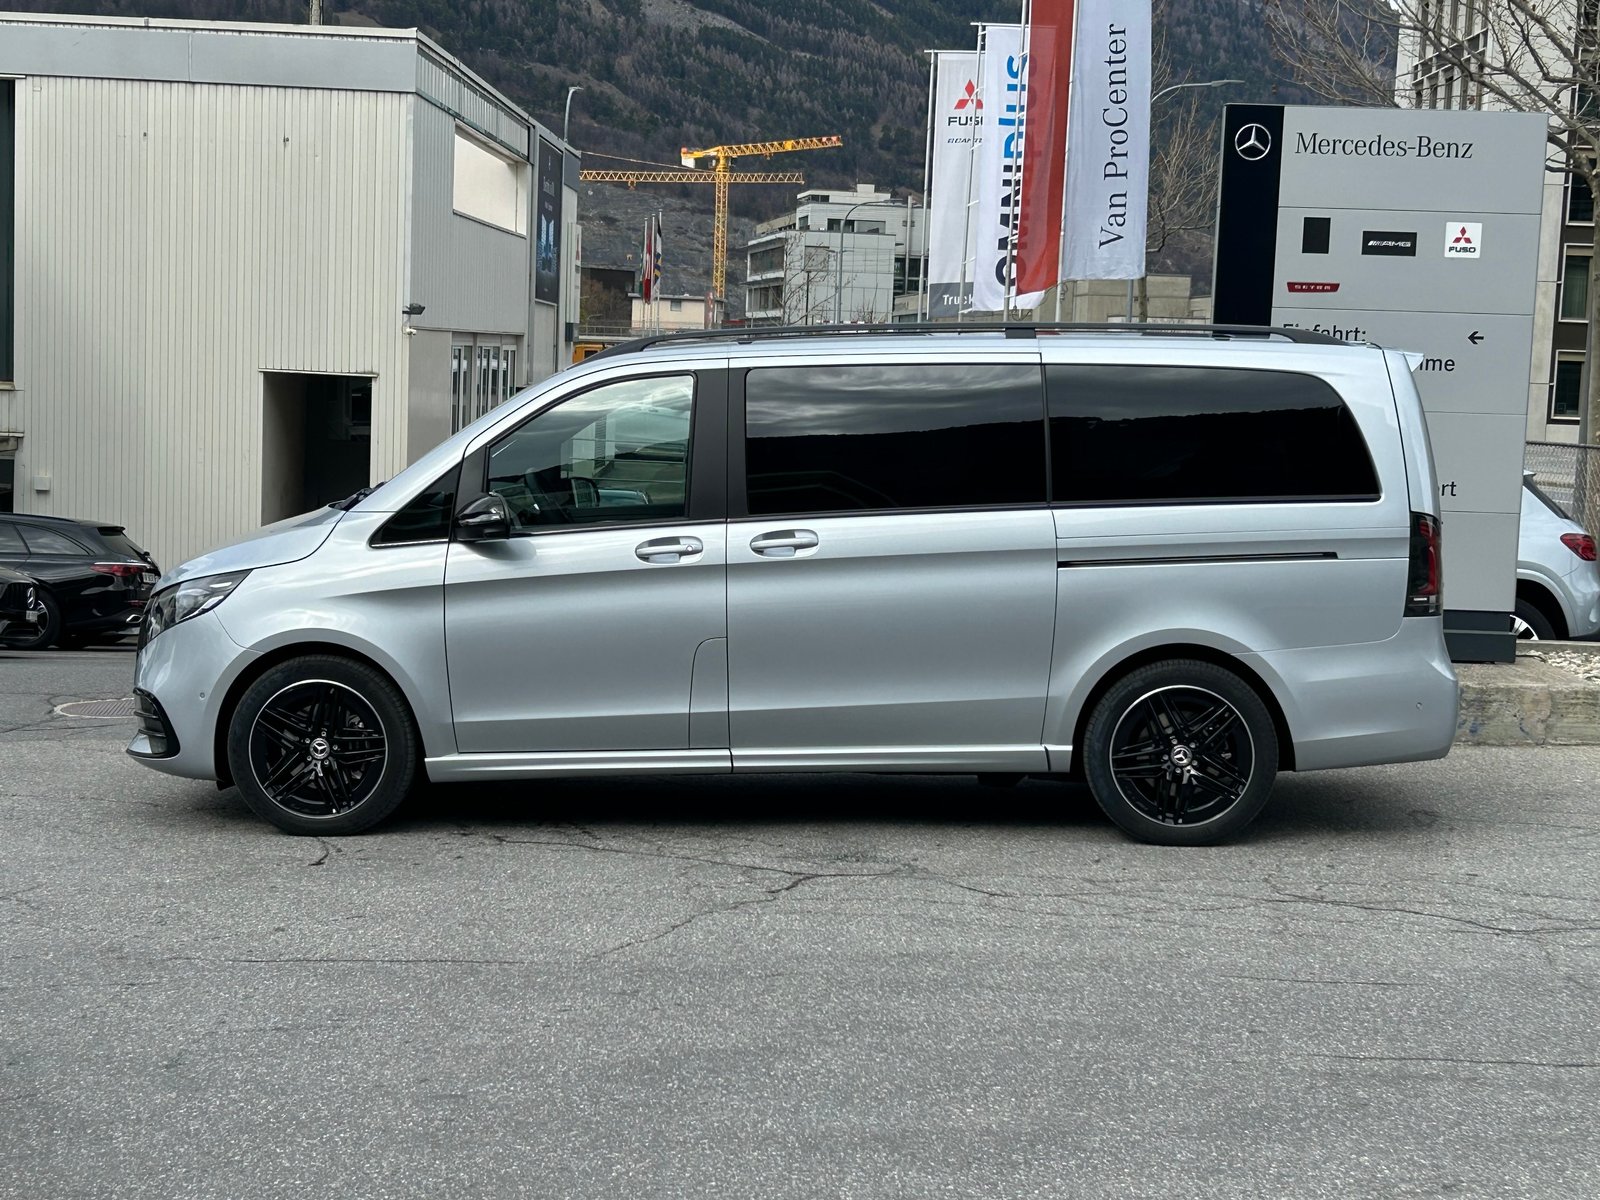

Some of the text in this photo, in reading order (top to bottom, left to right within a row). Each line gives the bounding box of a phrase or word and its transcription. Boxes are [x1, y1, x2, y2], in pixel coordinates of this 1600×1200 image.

[1098, 23, 1129, 250] Van ProCenter
[1294, 131, 1474, 159] Mercedes-Benz
[1448, 246, 1477, 254] FUSO
